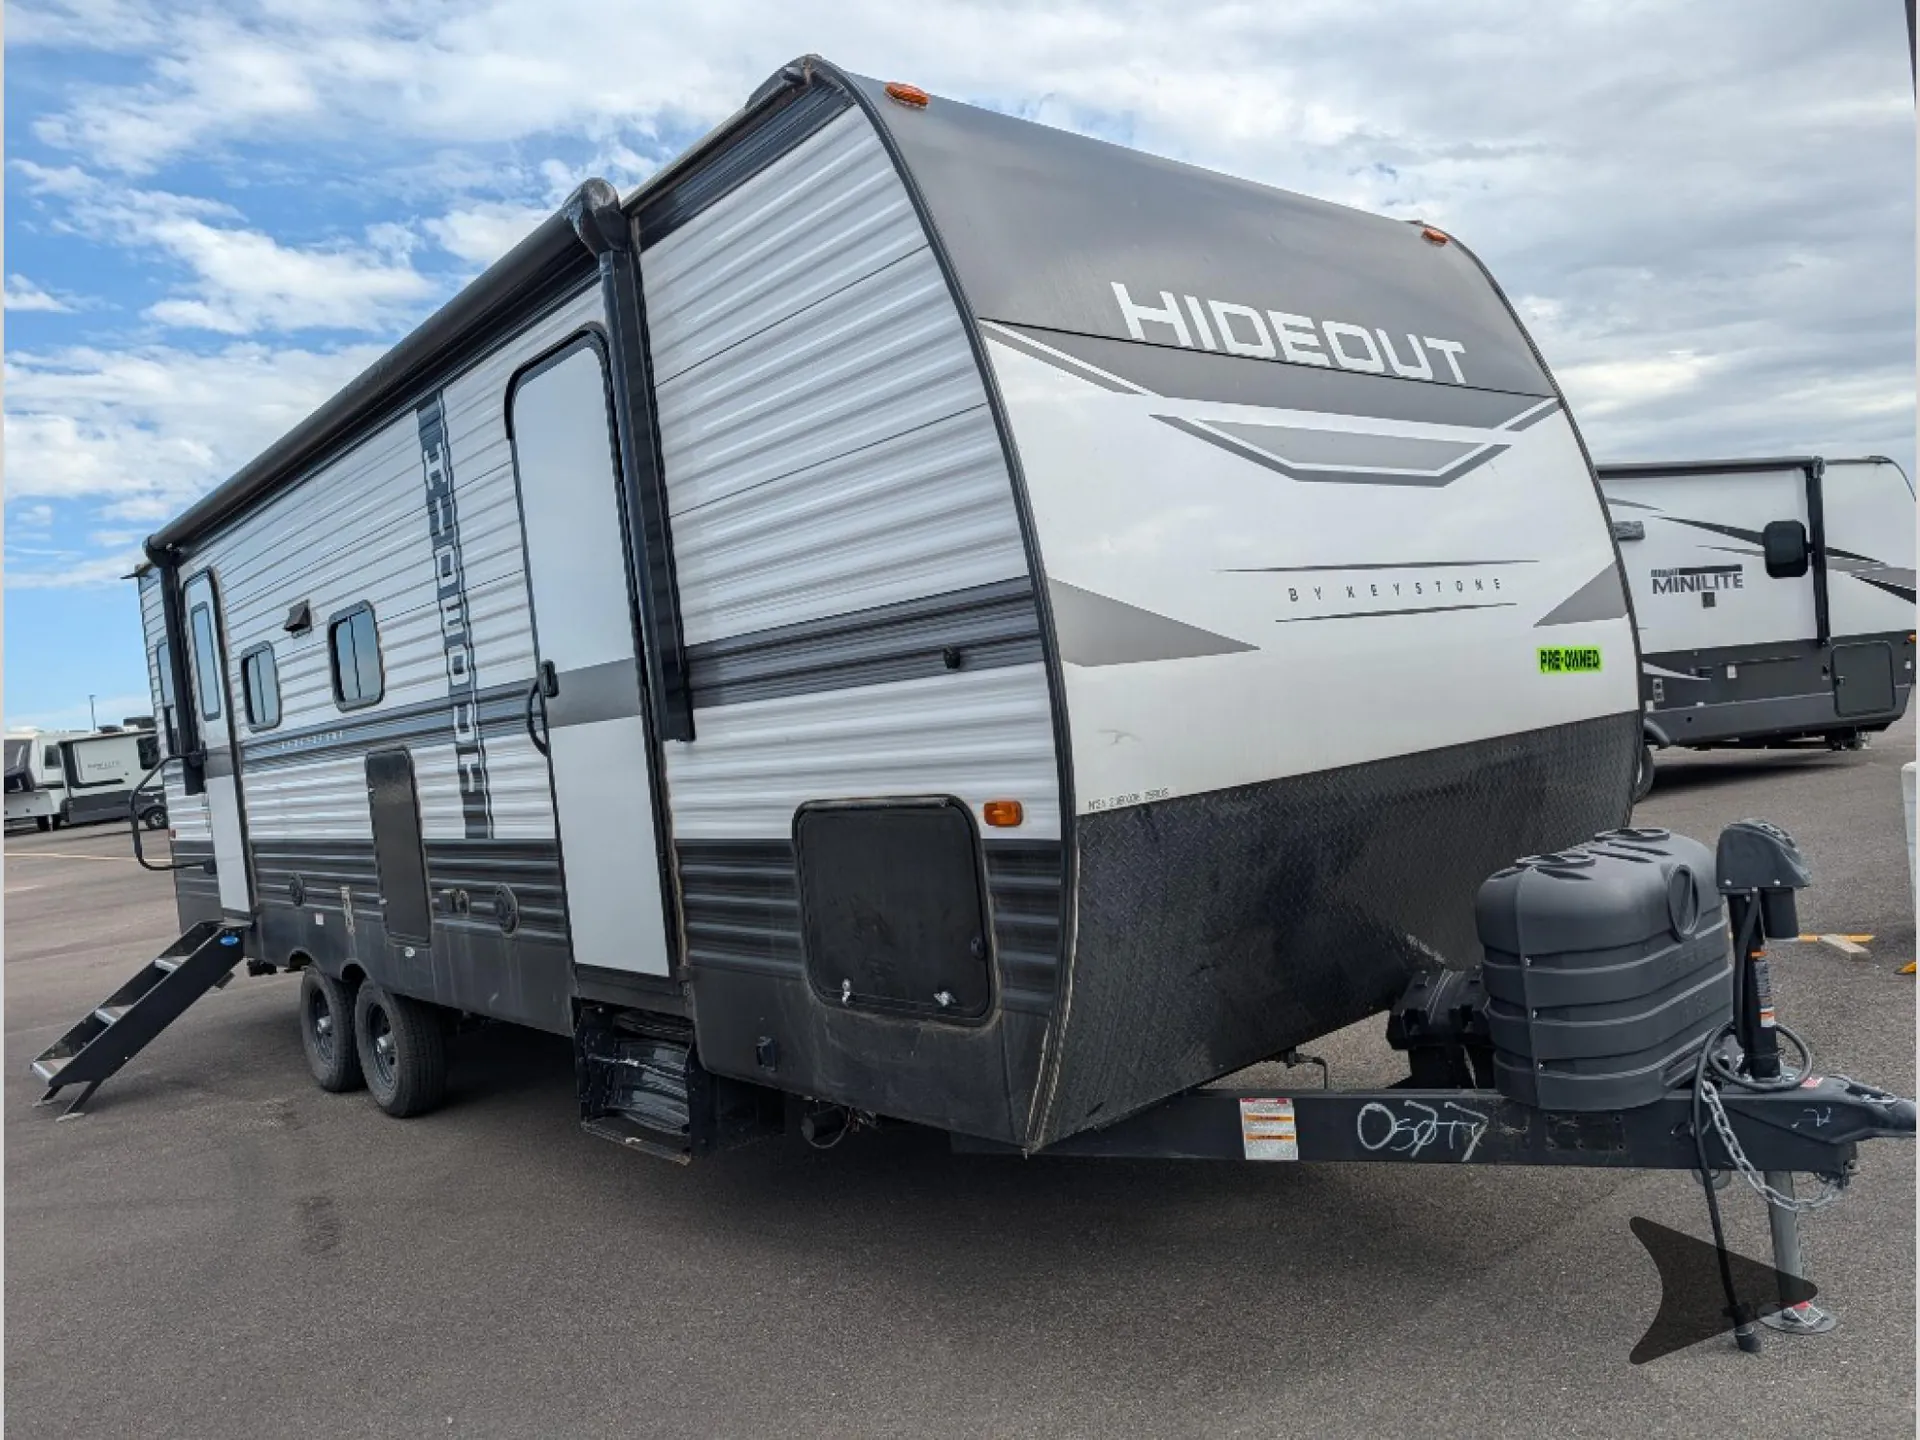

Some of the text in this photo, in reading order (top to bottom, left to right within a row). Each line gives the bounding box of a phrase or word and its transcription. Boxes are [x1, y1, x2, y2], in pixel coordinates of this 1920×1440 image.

[1110, 281, 1466, 384] HIDEOUT
[1287, 578, 1501, 602] BY KEYSTONE
[1652, 572, 1744, 595] MINILITE
[422, 440, 478, 794] HIDEOUT
[1540, 648, 1600, 671] PRE-OWNED
